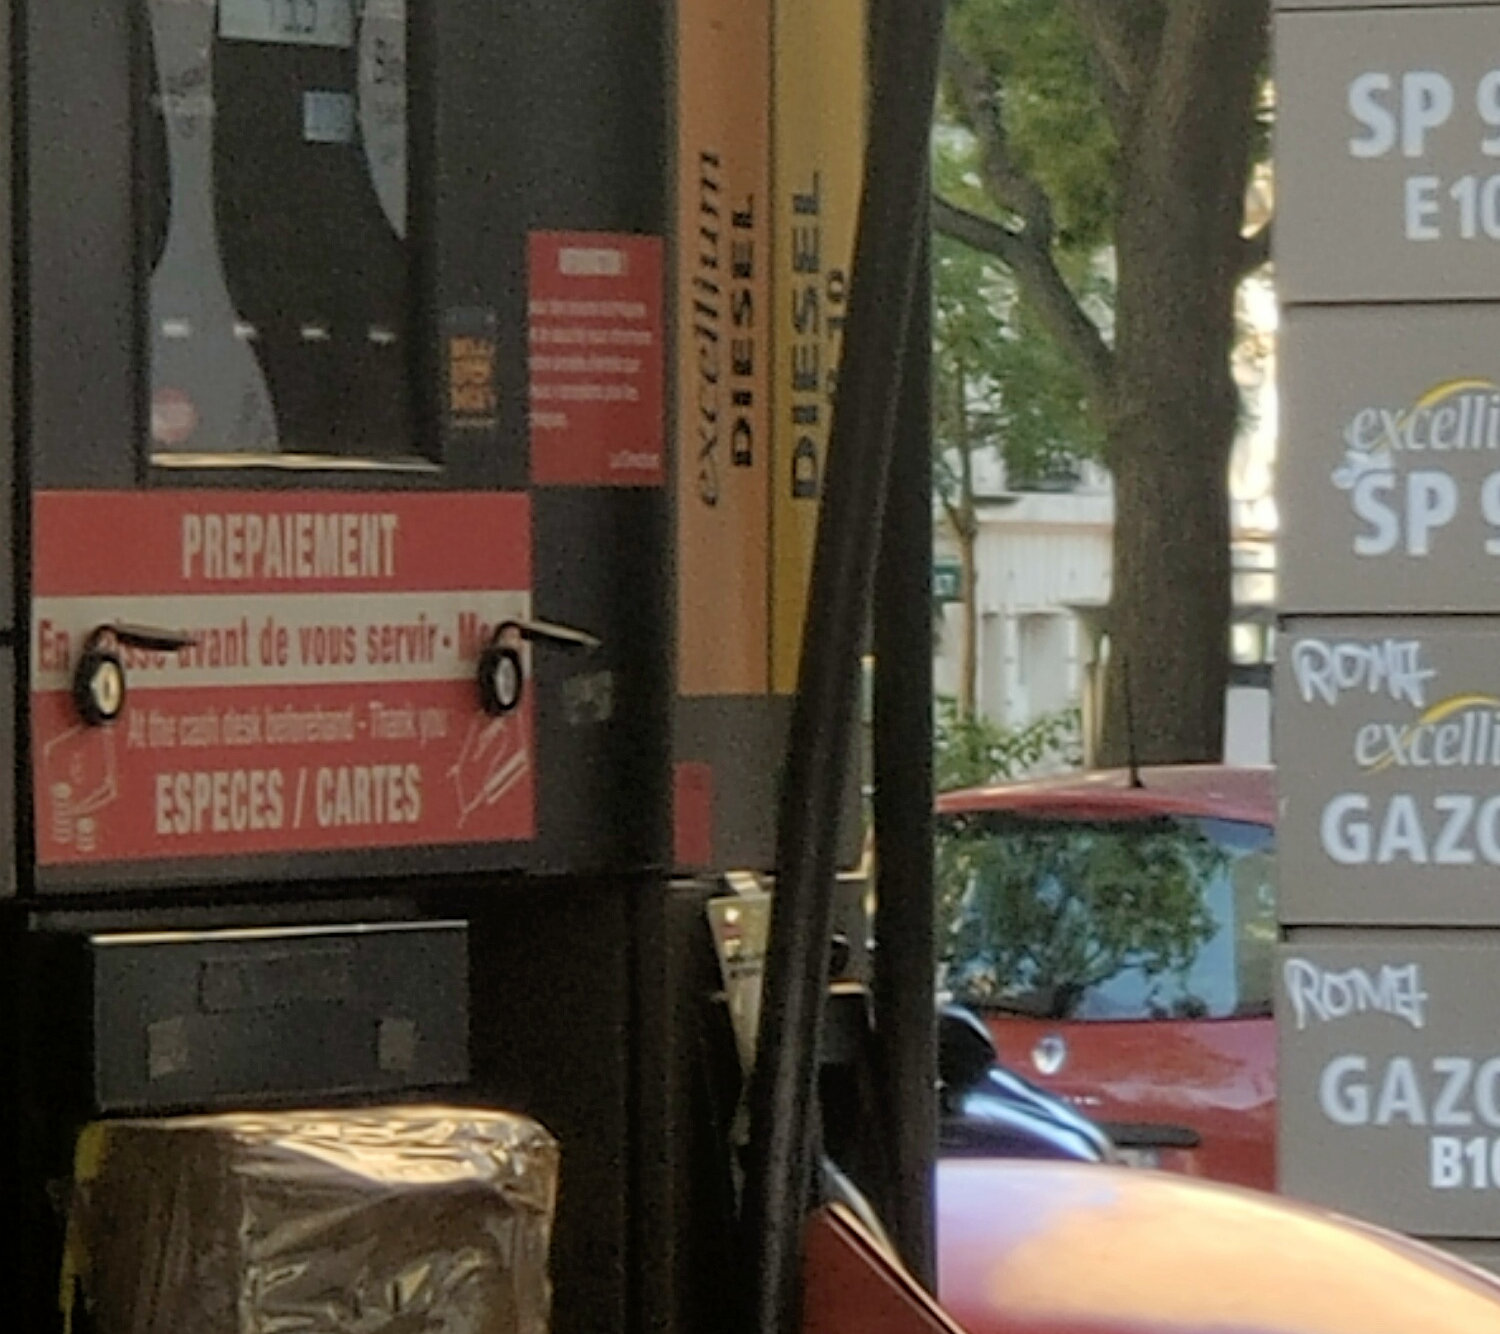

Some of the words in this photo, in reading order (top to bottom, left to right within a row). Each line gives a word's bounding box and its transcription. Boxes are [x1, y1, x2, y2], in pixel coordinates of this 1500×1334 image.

[1347, 70, 1454, 158] SP
[731, 194, 755, 467] DIESEL
[791, 170, 820, 500] DIESEL
[181, 513, 398, 579] PREPAIEMENT
[1353, 470, 1458, 556] SP
[39, 618, 69, 672] En
[259, 615, 289, 667] de
[299, 624, 356, 665] vous
[366, 613, 437, 665] servir
[156, 769, 283, 835] ESPECES
[316, 764, 422, 826] CARTES
